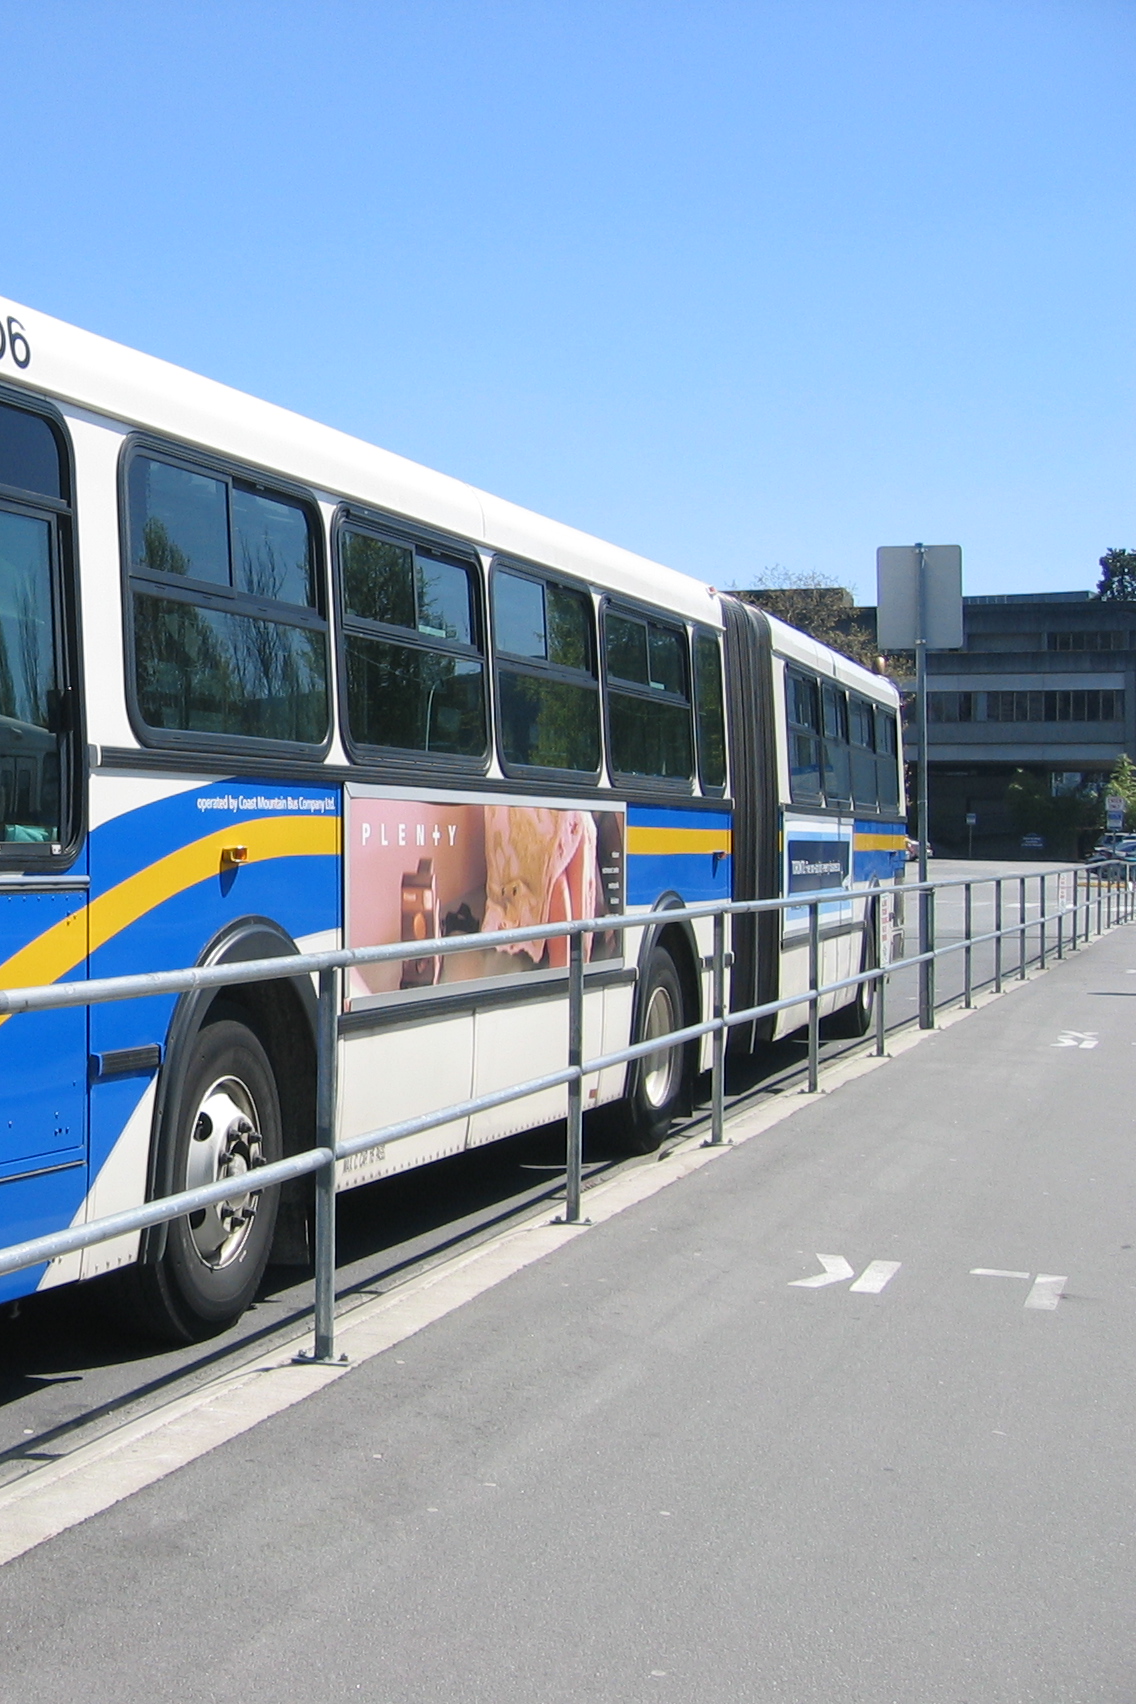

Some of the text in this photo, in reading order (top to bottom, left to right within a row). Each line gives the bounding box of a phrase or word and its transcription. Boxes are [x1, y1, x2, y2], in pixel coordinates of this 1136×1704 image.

[196, 795, 336, 814] operated by Coast Mountain Bus Company Ltd.
